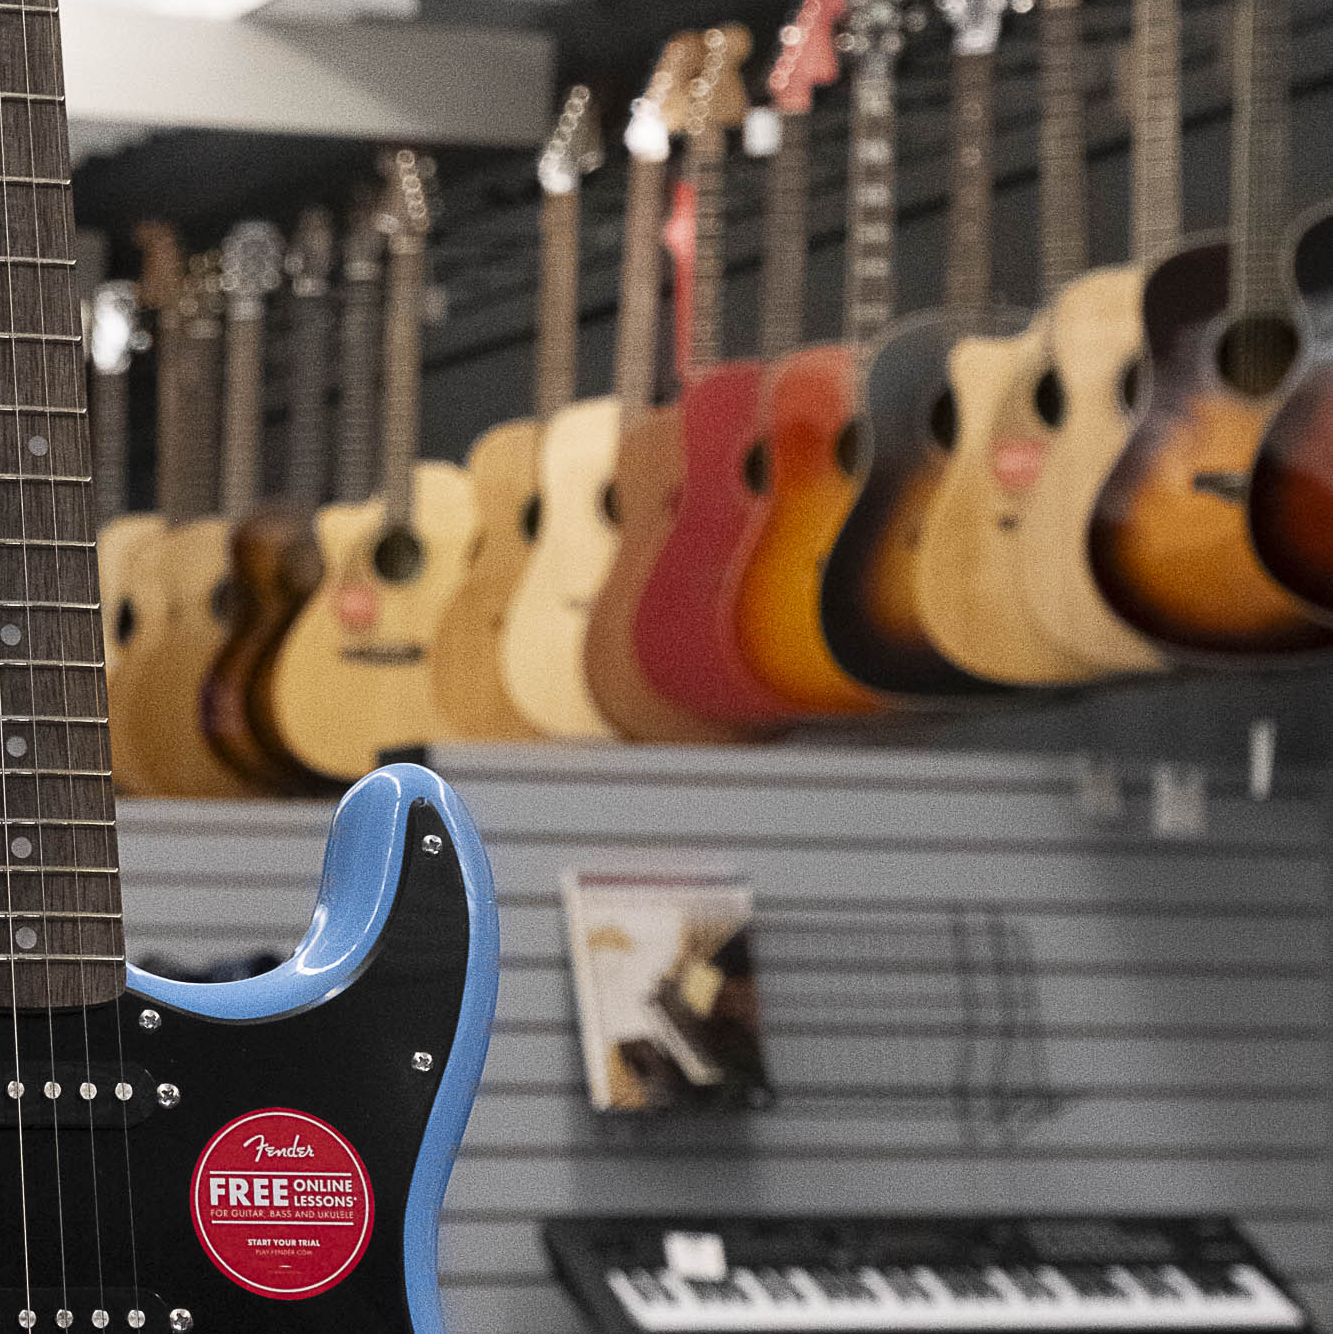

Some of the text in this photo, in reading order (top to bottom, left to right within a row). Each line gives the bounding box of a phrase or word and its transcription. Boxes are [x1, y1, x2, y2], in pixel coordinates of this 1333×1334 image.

[243, 1134, 315, 1163] Fender
[209, 1177, 353, 1207] FREE ONLINE
[210, 1209, 229, 1218] FOR
[269, 1210, 292, 1218] BASS
[295, 1210, 316, 1219] AND
[317, 1211, 355, 1220] UKULELE
[247, 1238, 321, 1247] START YOUR TRIAL
